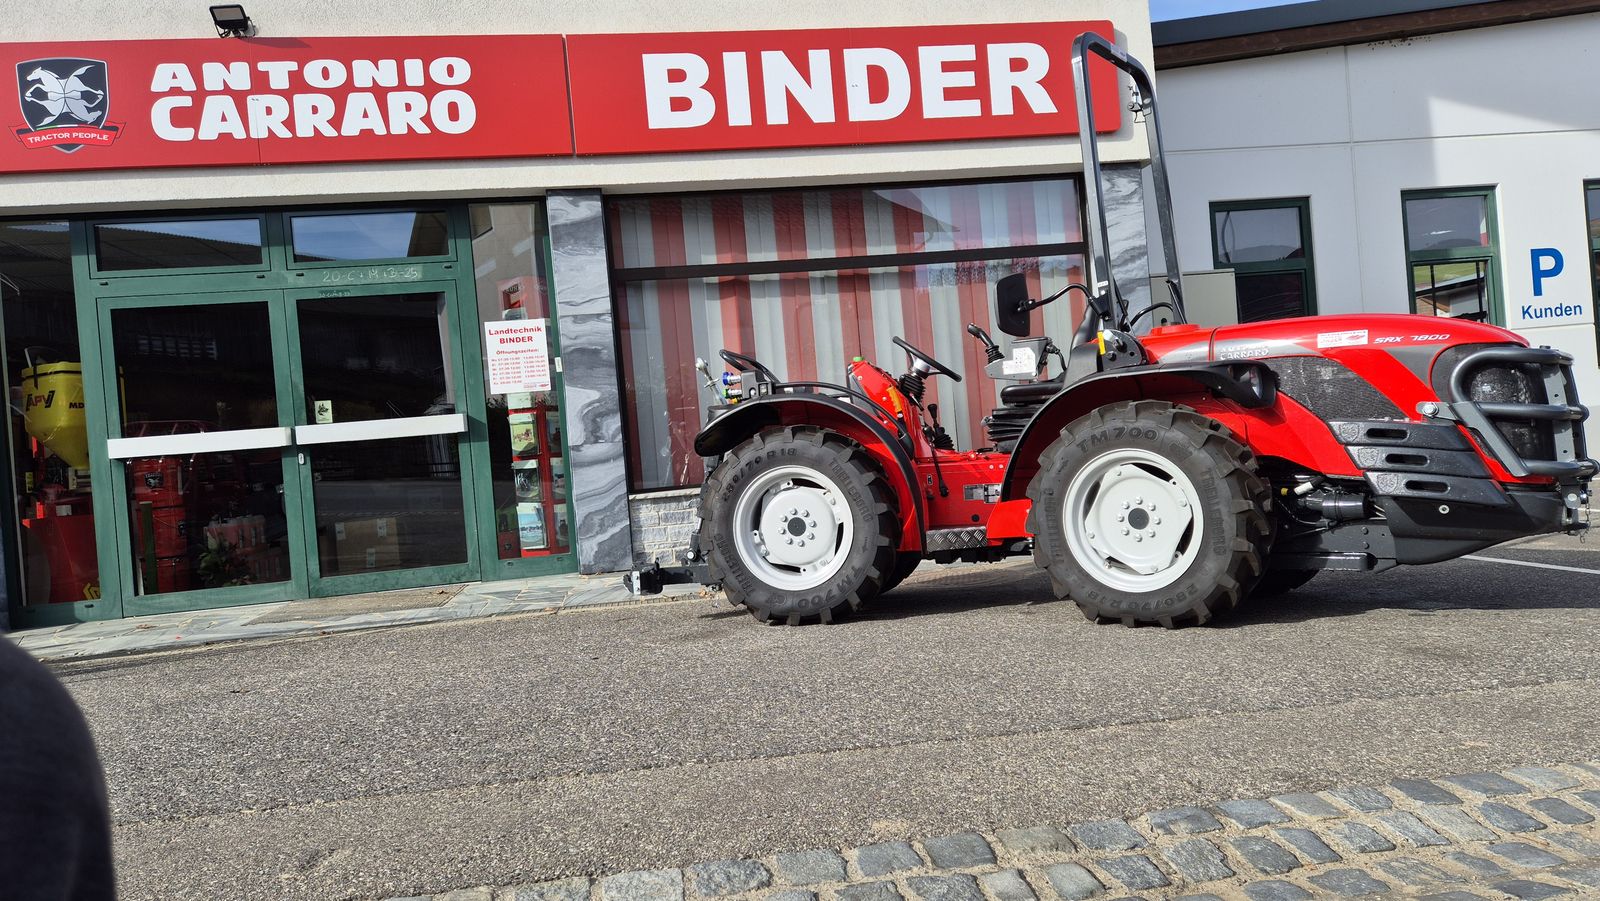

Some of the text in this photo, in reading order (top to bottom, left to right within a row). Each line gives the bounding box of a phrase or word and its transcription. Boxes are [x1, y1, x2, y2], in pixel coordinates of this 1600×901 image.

[150, 56, 472, 93] ANTONIO
[642, 43, 1058, 130] BINDER
[150, 90, 477, 142] CARRARO
[27, 131, 109, 144] TRACTOR PEOPLE
[1530, 247, 1564, 297] P
[1521, 302, 1583, 320] Kunden
[488, 325, 543, 336] Landtechnik
[499, 335, 534, 345] BINDER
[1373, 336, 1404, 345] SRX
[1410, 333, 1451, 342] 7800
[1220, 347, 1270, 361] CARRARO
